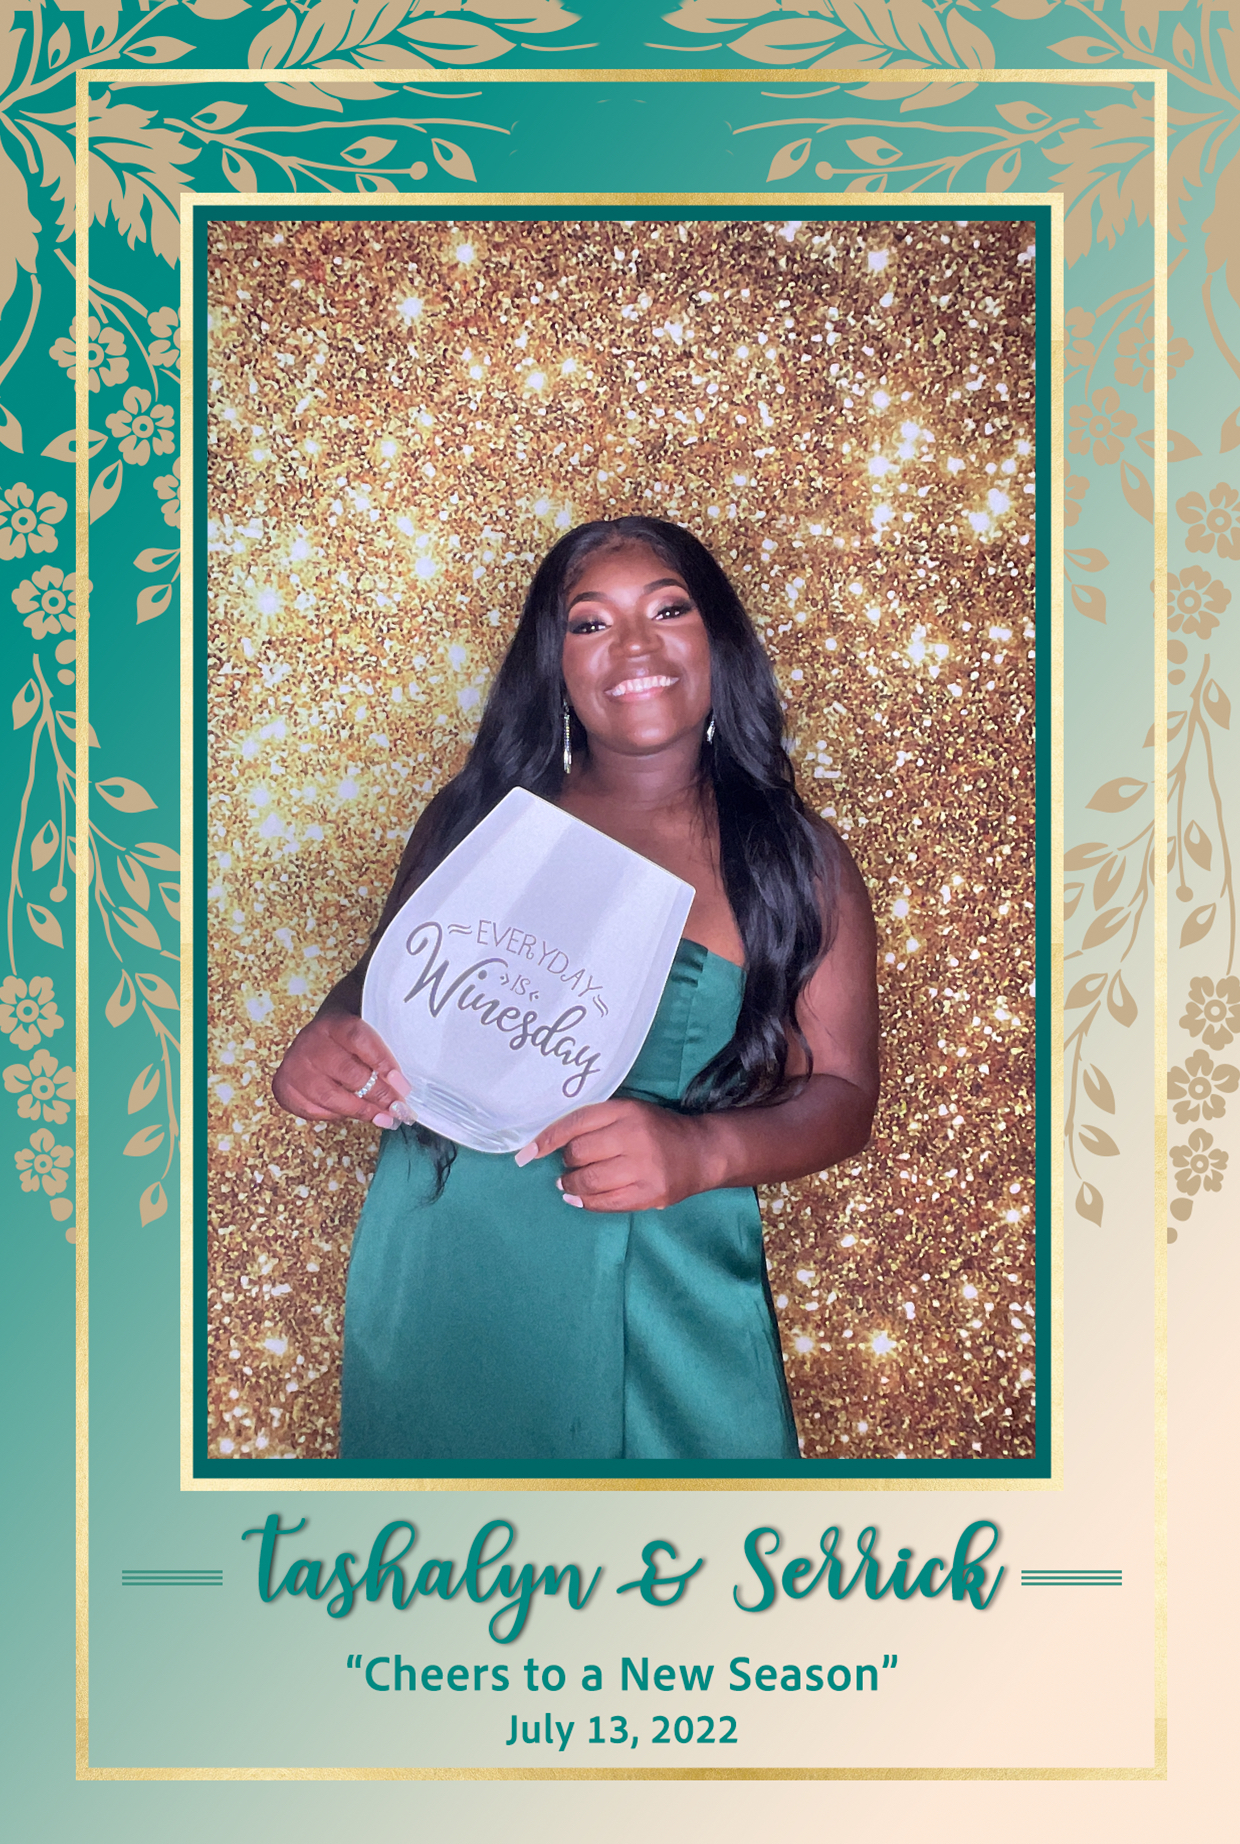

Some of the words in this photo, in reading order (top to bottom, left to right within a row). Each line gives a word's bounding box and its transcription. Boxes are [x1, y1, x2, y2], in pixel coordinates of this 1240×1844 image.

[476, 919, 603, 998] EVERYDAY
[509, 975, 532, 997] IS
[403, 920, 602, 1099] Winesday
